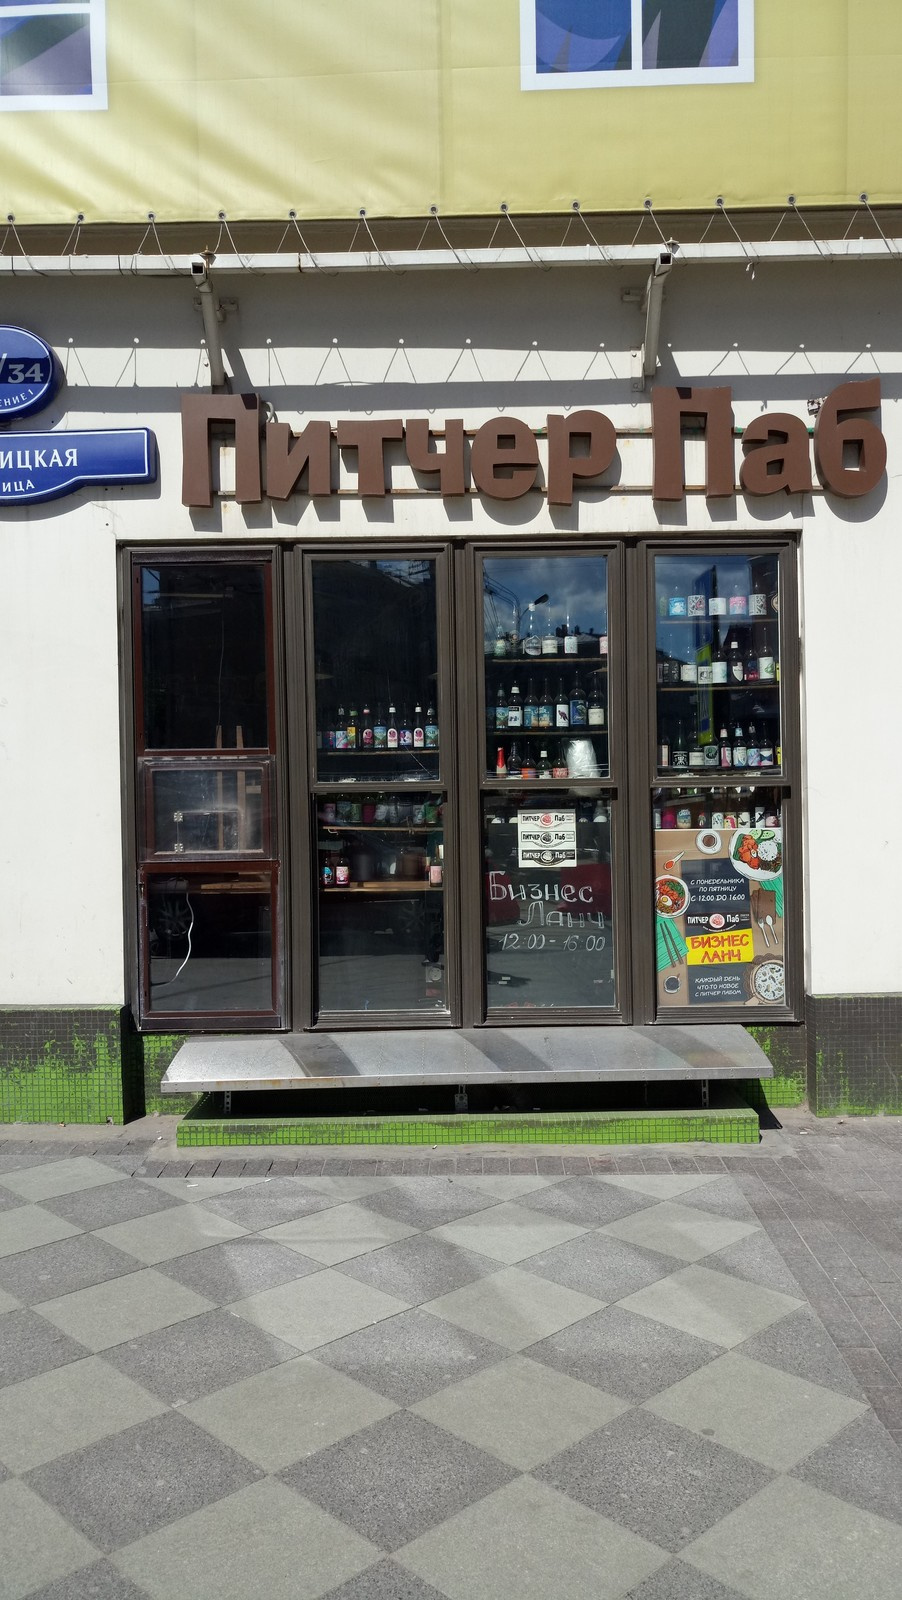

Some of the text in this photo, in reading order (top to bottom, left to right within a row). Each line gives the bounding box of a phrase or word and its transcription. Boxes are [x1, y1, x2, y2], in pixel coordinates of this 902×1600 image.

[182, 378, 887, 506] Питчер Паб
[0, 448, 79, 471] ИЦКАЯ
[2, 479, 36, 493] ИЦА
[489, 870, 593, 903] Бизнес
[696, 877, 745, 885] ПОНЕДЕЛЬНИКА
[716, 894, 728, 902] ДО
[517, 900, 605, 929] Ланч
[499, 933, 546, 950] 12:00
[690, 934, 749, 948] БИЗНЕС
[701, 949, 742, 963] ЛАНЧ
